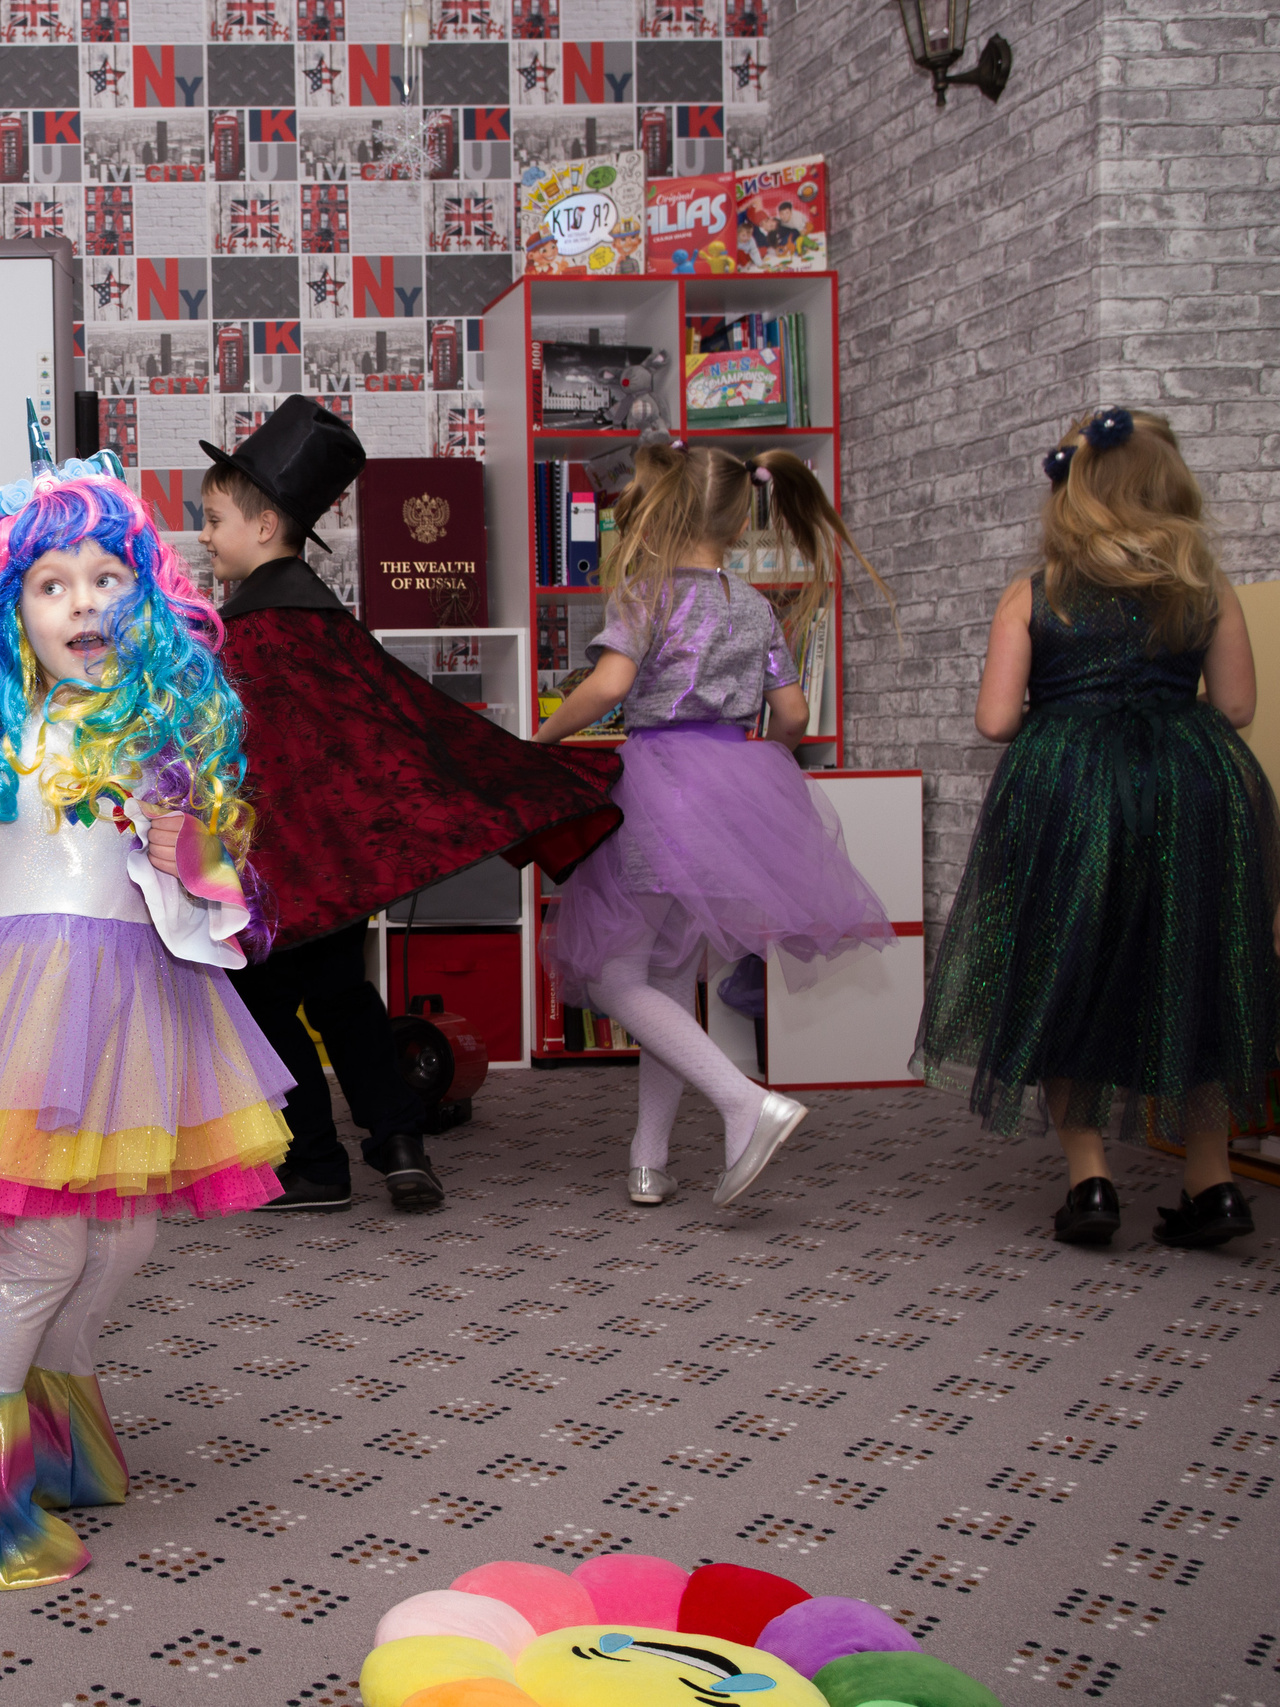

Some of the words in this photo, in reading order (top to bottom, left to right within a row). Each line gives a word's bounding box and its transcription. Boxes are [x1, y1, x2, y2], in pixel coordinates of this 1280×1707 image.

[43, 28, 50, 37] a
[258, 27, 266, 35] a
[430, 20, 448, 40] ife
[473, 25, 481, 34] a
[687, 24, 695, 32] a
[656, 188, 695, 206] Original
[590, 203, 610, 233] Я?
[646, 194, 727, 235] ALIAS
[263, 239, 271, 248] a
[477, 237, 485, 246] a
[531, 342, 542, 370] 1000
[703, 357, 760, 377] ENGLISH
[380, 561, 411, 573] THE
[413, 561, 476, 573] WEALTH
[391, 577, 412, 590] OF
[415, 577, 467, 590] RUSSIA
